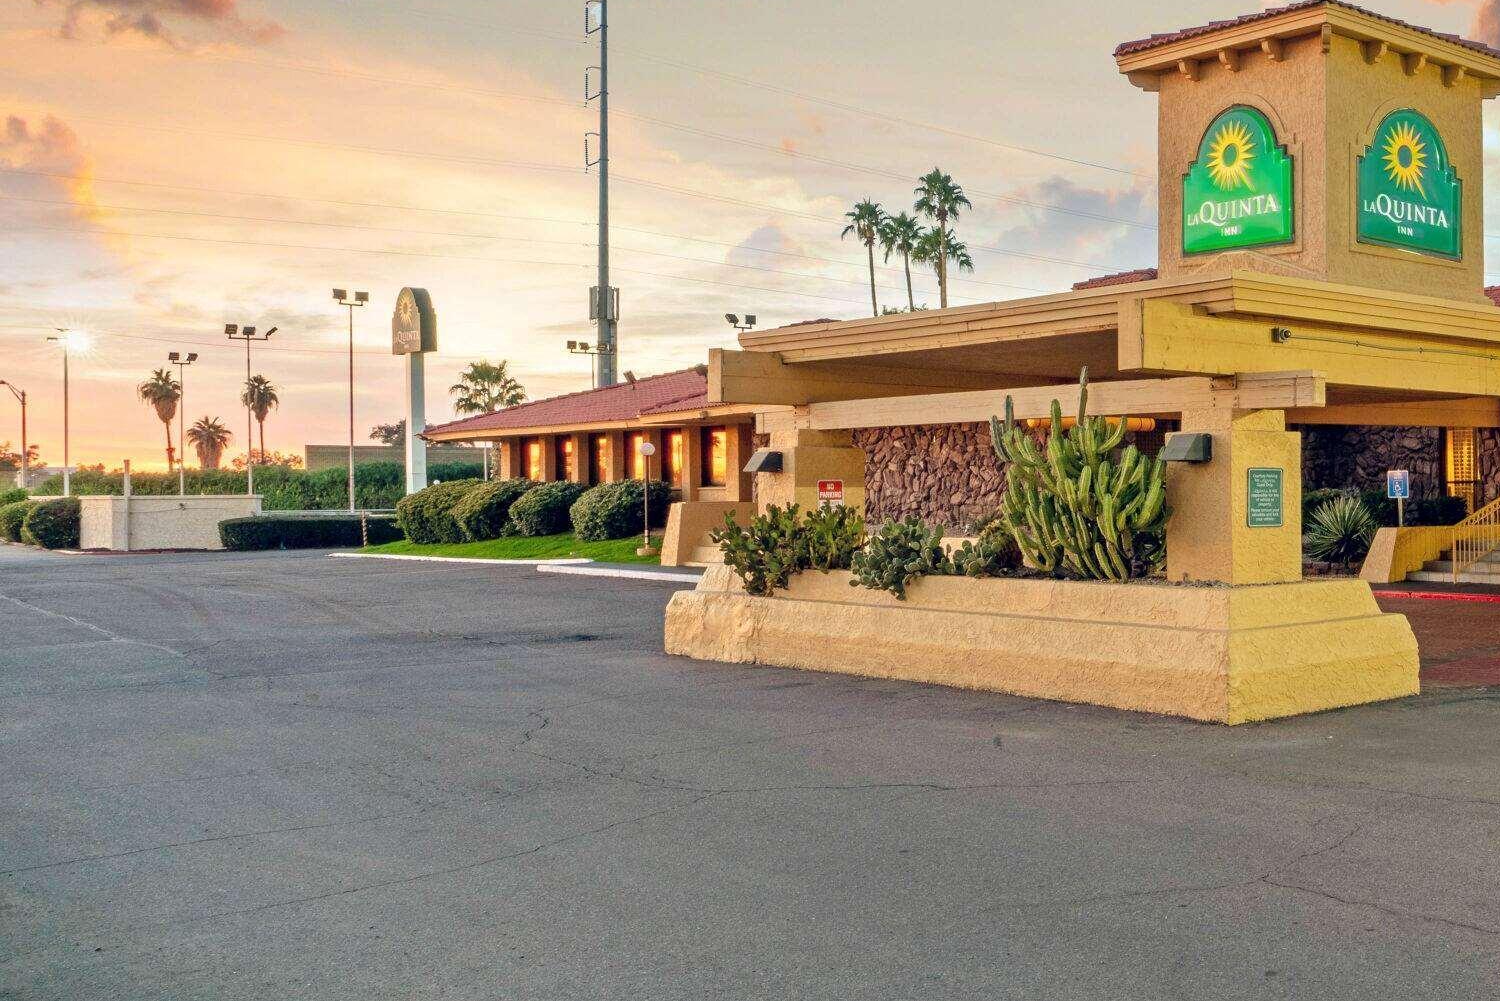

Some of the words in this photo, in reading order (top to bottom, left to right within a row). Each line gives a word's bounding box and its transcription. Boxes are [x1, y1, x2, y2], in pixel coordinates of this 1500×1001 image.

[1200, 194, 1280, 226] QUINTA
[1364, 200, 1376, 213] LA
[1376, 193, 1448, 228] QUINTA
[1397, 226, 1413, 237] INN
